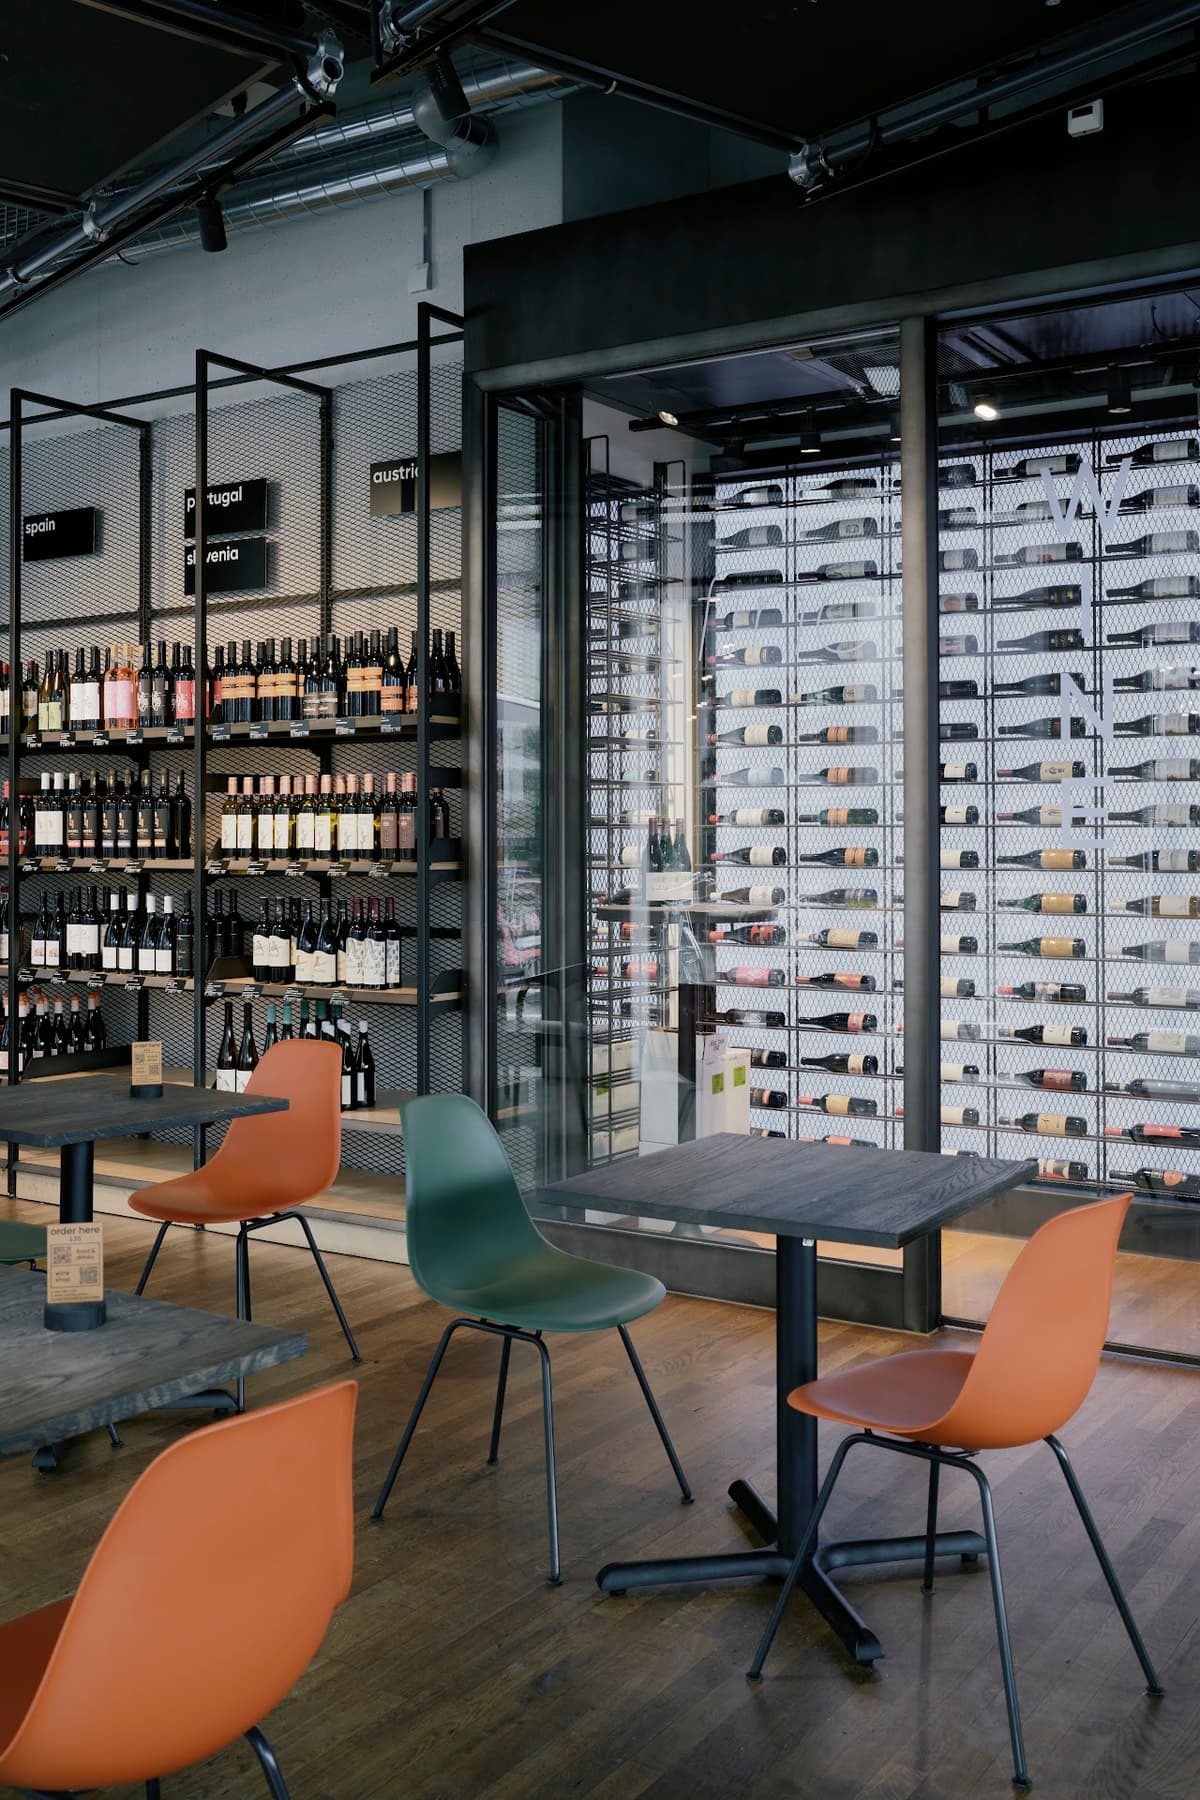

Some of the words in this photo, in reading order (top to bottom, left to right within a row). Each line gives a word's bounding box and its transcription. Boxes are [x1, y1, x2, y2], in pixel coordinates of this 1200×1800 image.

[187, 485, 243, 512] ptugal
[25, 517, 56, 535] spain
[186, 545, 239, 566] slvenia
[1040, 457, 1133, 848] WINE
[50, 1227, 76, 1236] order
[78, 1226, 100, 1234] here
